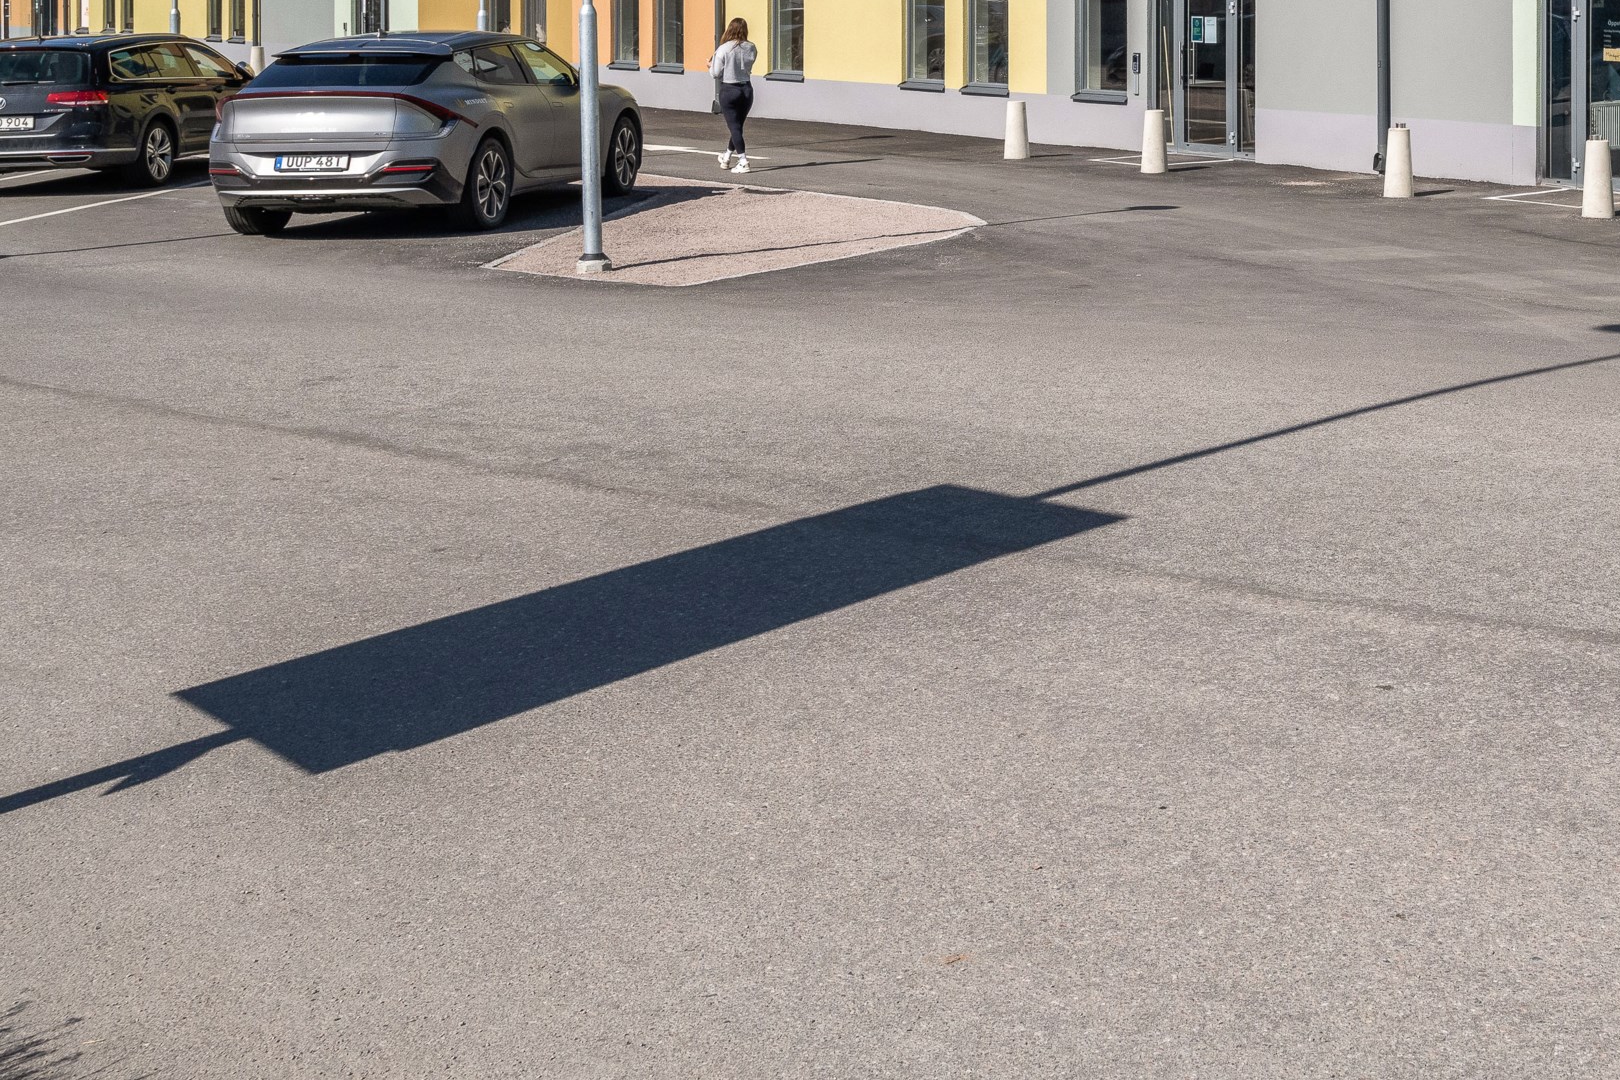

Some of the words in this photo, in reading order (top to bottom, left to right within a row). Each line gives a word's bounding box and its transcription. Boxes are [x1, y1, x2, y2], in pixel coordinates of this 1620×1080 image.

[6, 117, 28, 127] 904
[286, 156, 313, 168] UUP
[316, 155, 343, 168] 48T
